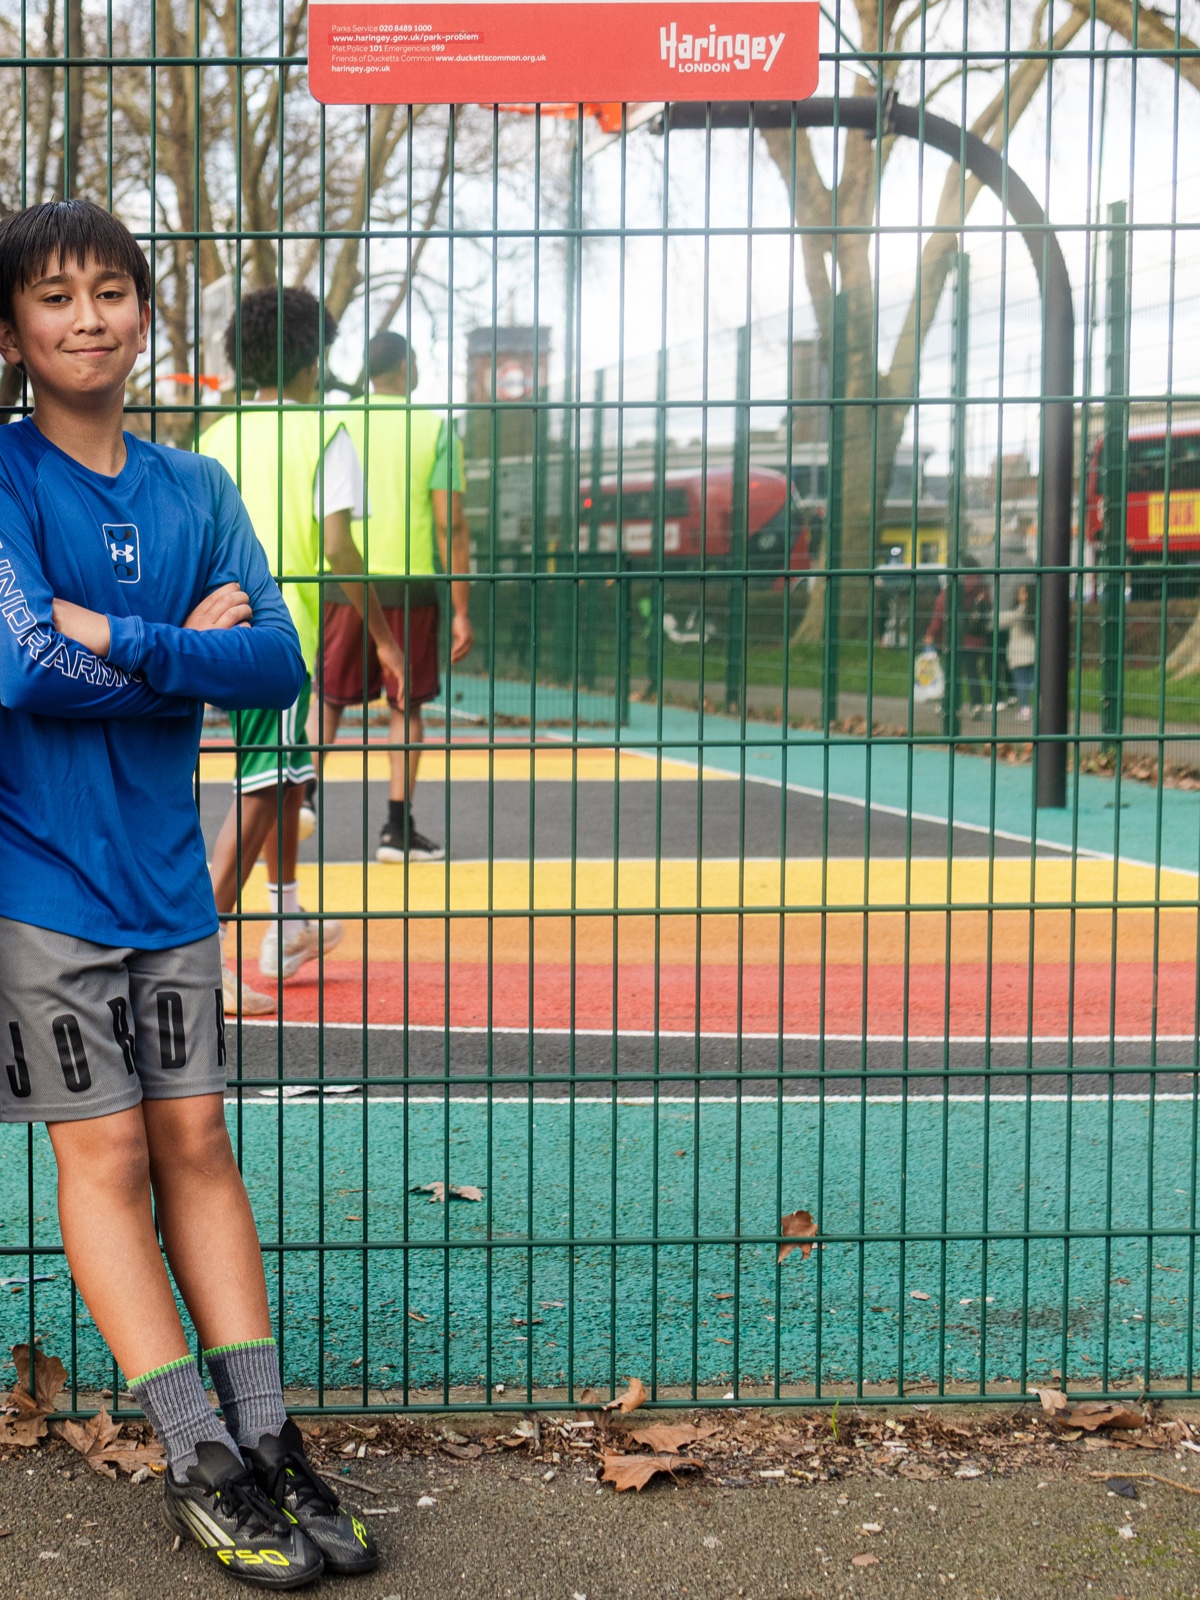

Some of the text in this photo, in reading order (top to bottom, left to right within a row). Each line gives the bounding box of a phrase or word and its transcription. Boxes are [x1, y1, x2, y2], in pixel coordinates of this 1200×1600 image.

[331, 24, 432, 32] Parks Service 020 8489 1000
[333, 33, 479, 43] www.haringey.gov.uk/park-problem
[331, 44, 445, 53] Met Police 101 Emergencies 999
[660, 22, 786, 72] Haringey
[331, 54, 546, 63] Friends of Ducketts Common www.duckettscommon.org.uk
[331, 65, 390, 74] haringey.gov.uk
[678, 63, 730, 73] LONDON
